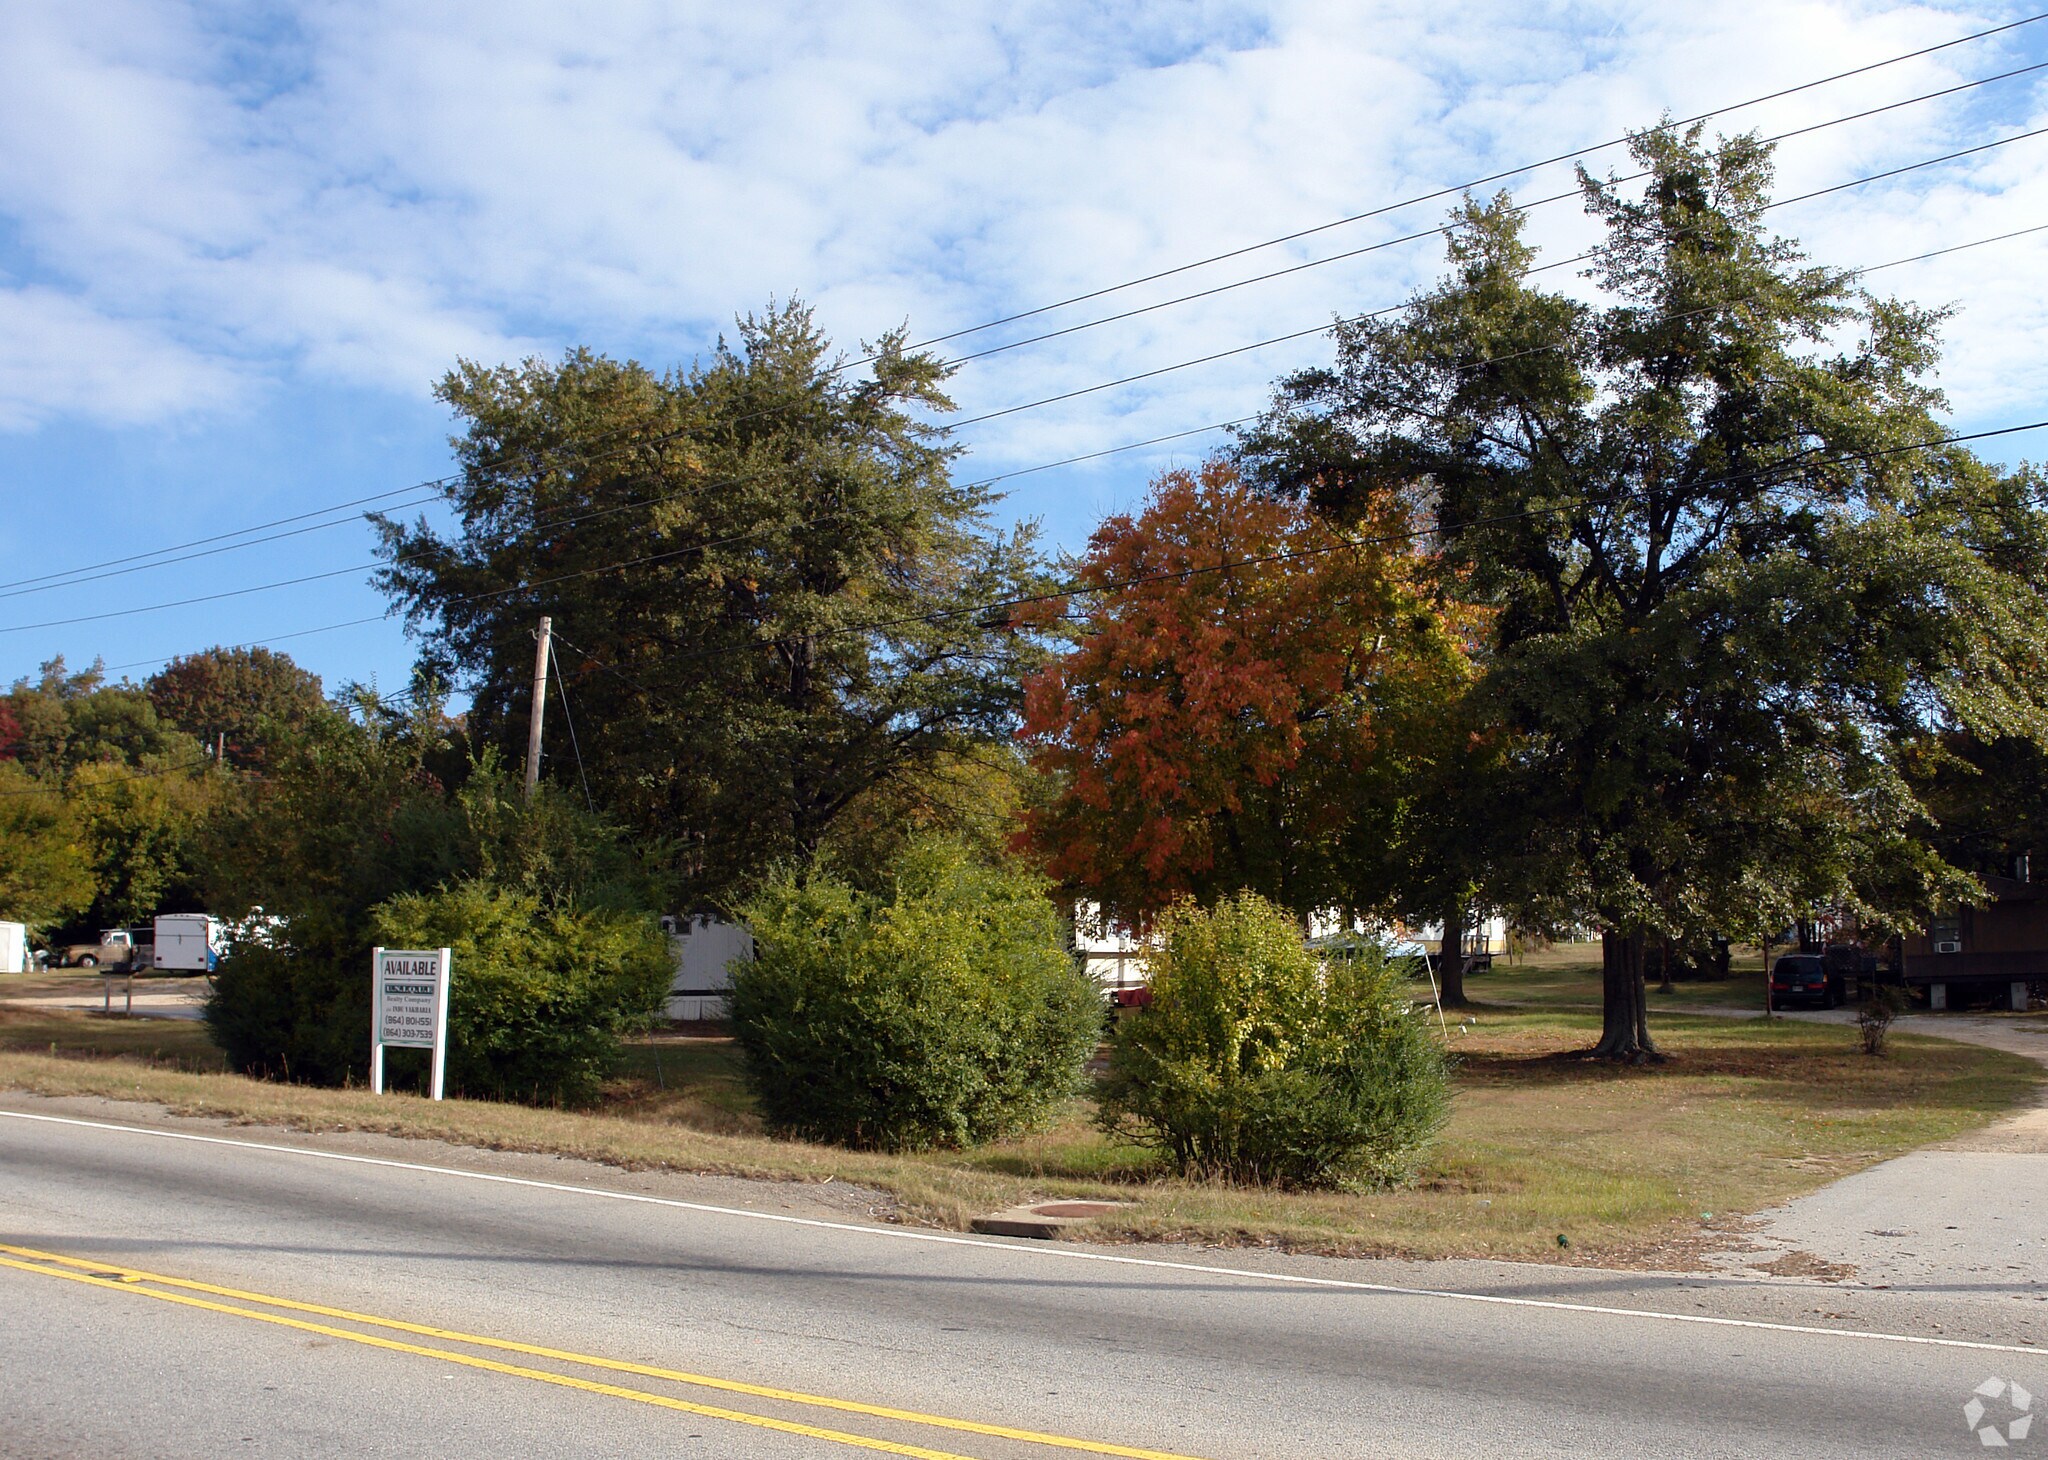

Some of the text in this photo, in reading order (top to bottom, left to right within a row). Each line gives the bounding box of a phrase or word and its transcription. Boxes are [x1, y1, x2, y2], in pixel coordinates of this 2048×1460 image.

[384, 960, 437, 975] AVAILABLE
[404, 996, 431, 1004] Company
[385, 1015, 404, 1025] (864)
[383, 1027, 402, 1038] (864)
